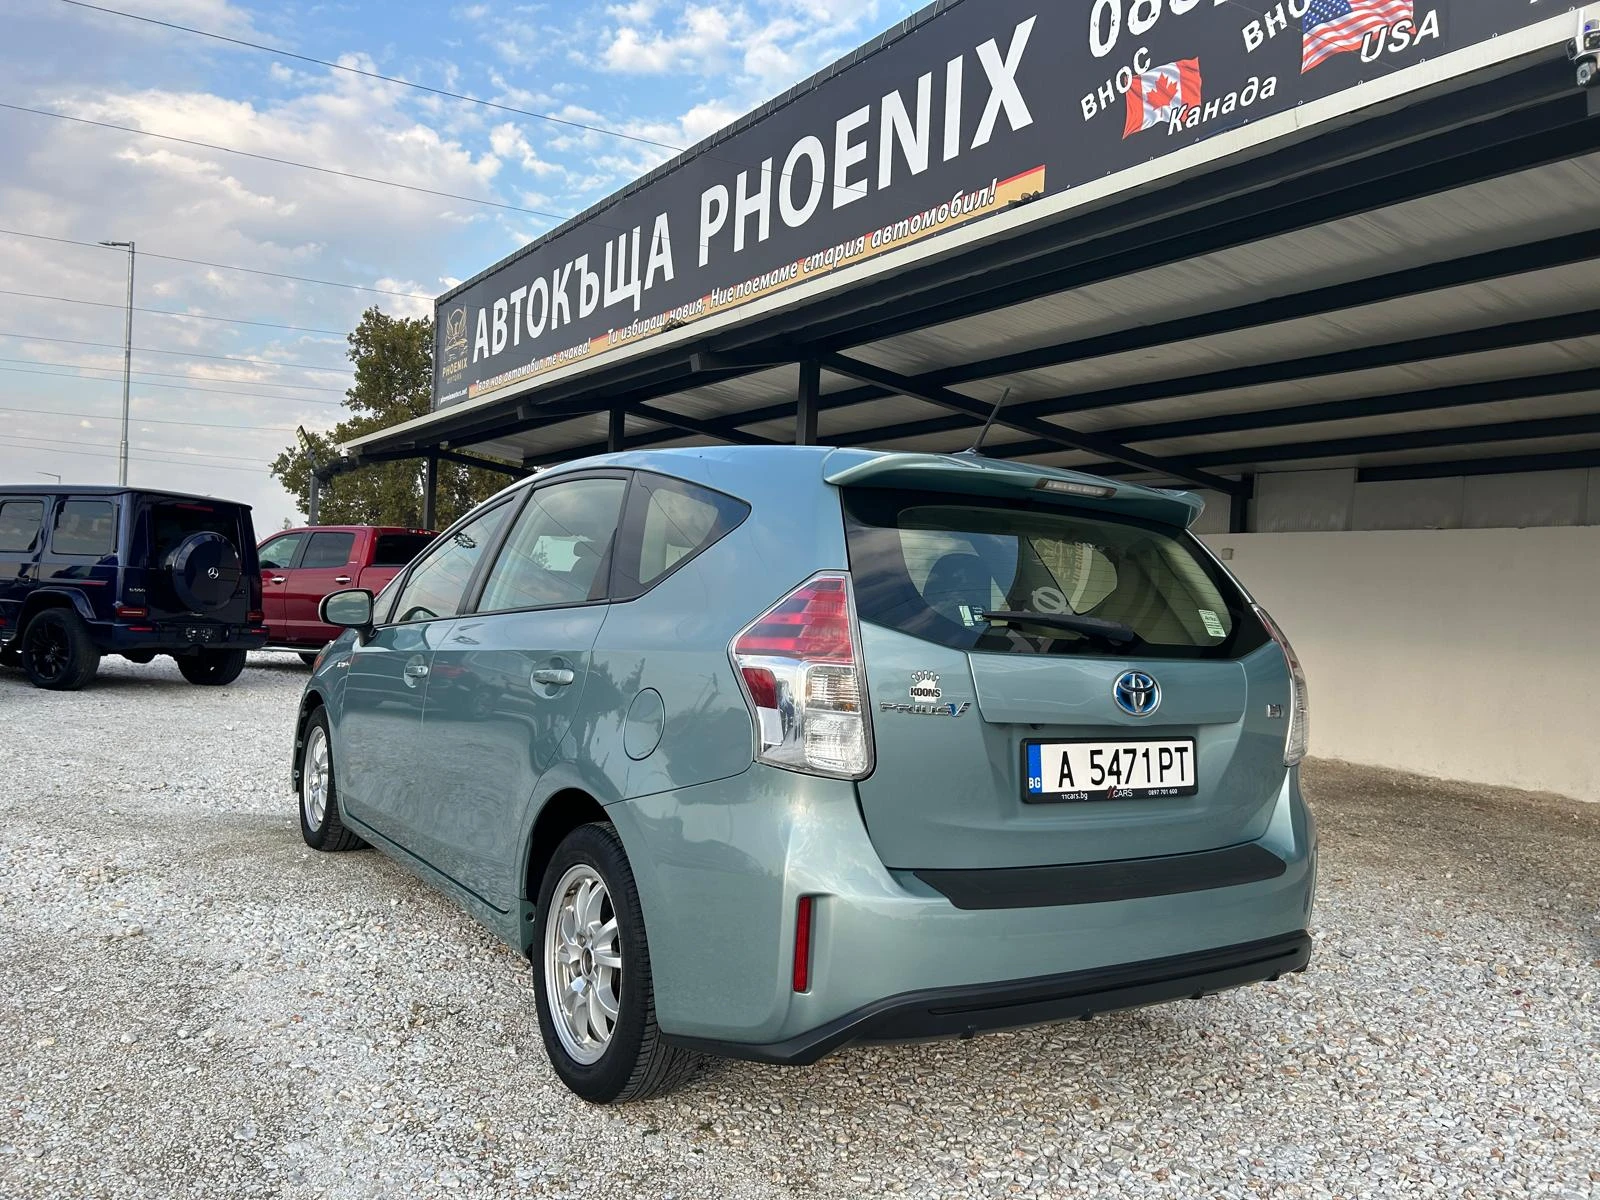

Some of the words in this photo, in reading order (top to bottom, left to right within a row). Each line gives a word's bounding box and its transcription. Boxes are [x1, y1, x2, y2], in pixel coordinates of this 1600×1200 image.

[1360, 9, 1440, 63] USA
[1080, 46, 1151, 121] ВНОС
[1167, 76, 1277, 135] Канада
[473, 212, 675, 364] АВТОКЪЩА
[698, 14, 1037, 267] PHOENIX
[607, 328, 619, 346] Ти
[620, 313, 667, 341] избираш
[669, 297, 706, 323] новия,
[710, 287, 734, 308] Ние
[735, 261, 798, 298] поемаме
[803, 235, 865, 273] стария
[870, 178, 998, 248] автомобил!
[442, 357, 468, 377] PHOENIX
[504, 357, 544, 381] автомобил
[559, 338, 591, 363] очаква!
[910, 687, 941, 698] KOONS
[1028, 777, 1041, 789] BG
[1058, 750, 1075, 788] A
